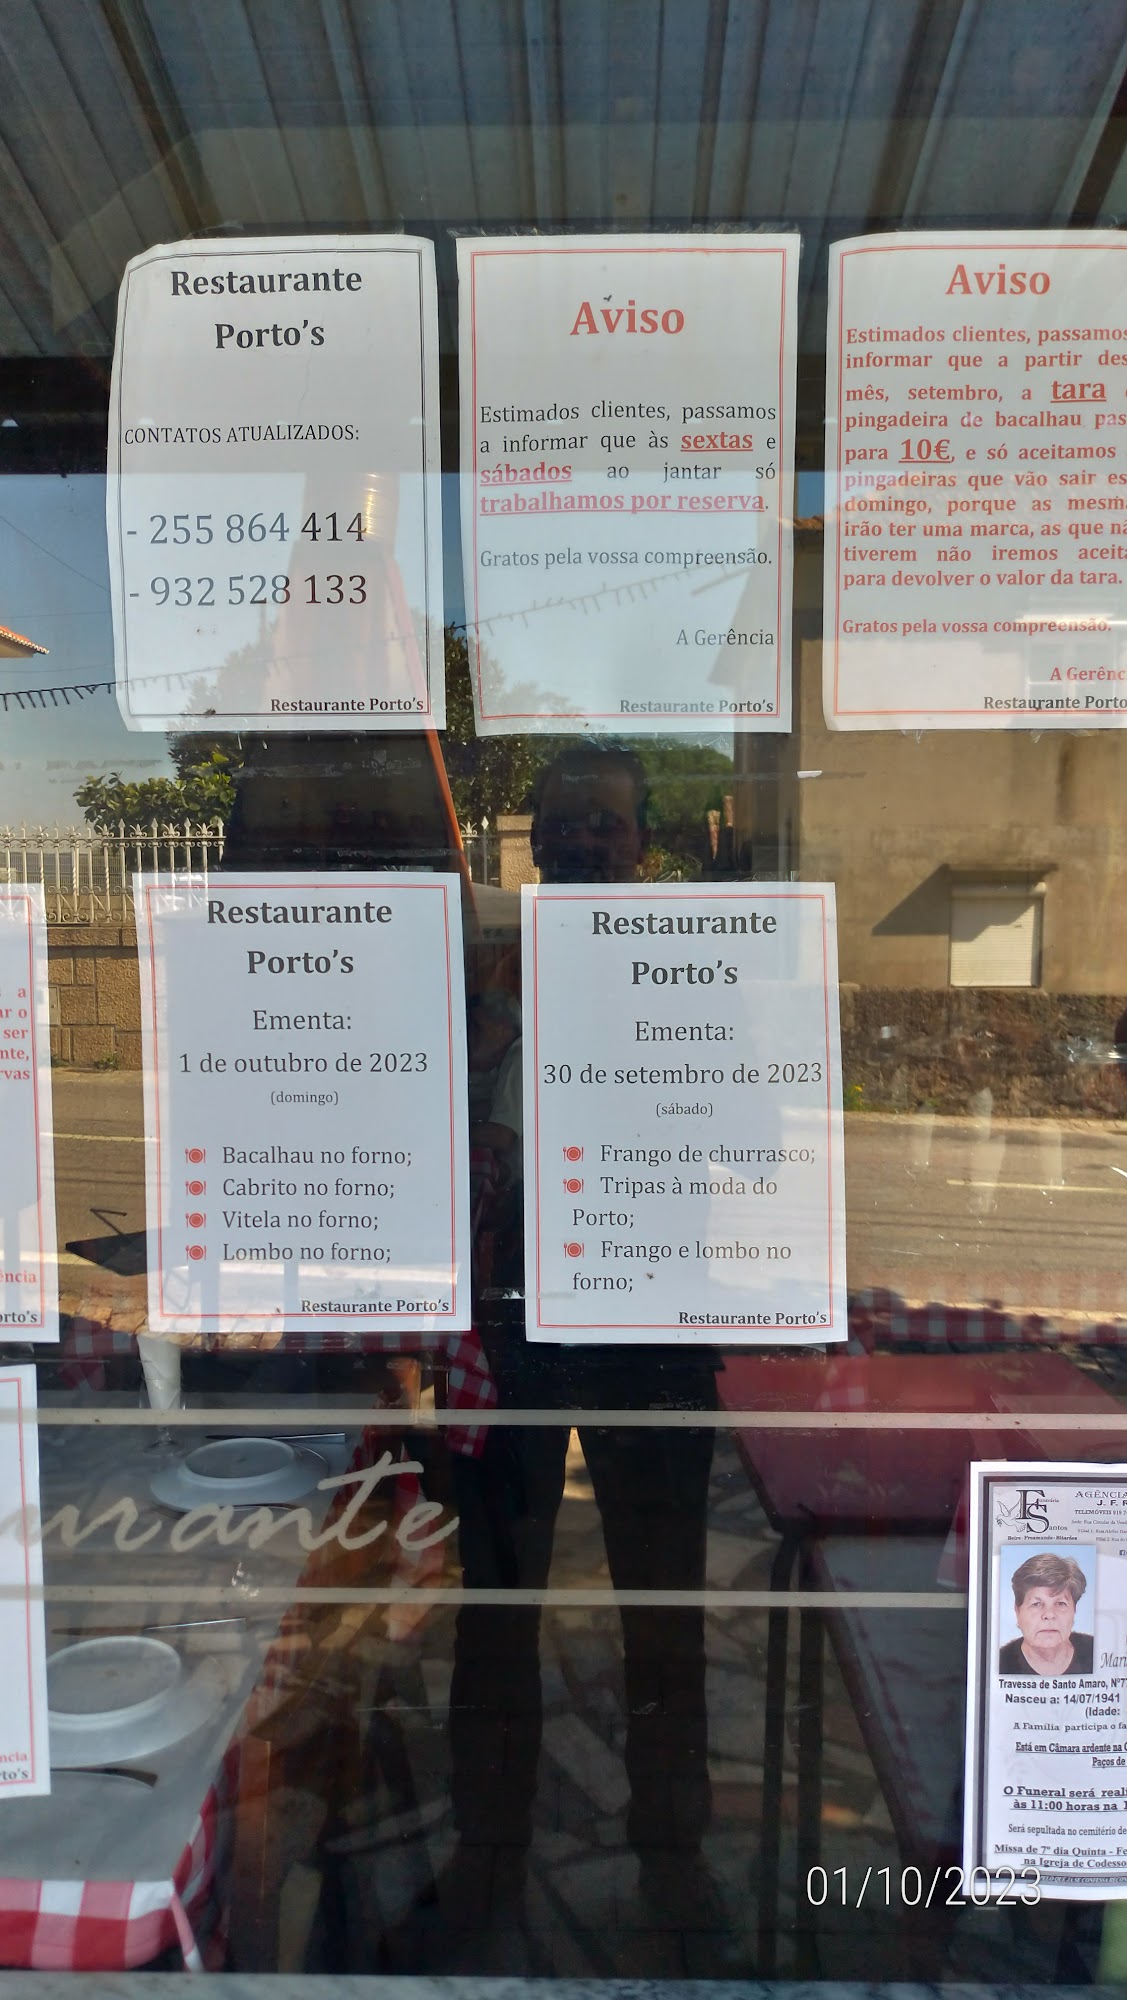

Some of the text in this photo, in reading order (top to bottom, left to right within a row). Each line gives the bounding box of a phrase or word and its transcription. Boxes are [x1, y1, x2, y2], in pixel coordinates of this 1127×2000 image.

[170, 268, 363, 296] Restaurante
[945, 263, 1051, 296] Aviso
[569, 299, 685, 336] Aviso
[214, 319, 325, 349] Porto's
[846, 325, 1031, 345] Estimados clientes,
[845, 350, 1083, 371] informar que partir
[845, 380, 1107, 404] mês, setembro, tara
[480, 399, 776, 424] Estimados clientes, passamos
[845, 410, 1127, 432] pingadeira de bacalhau pas
[124, 424, 359, 445] CONTATOS ATUALIZADOS:
[502, 430, 753, 453] informar que às sextas
[844, 438, 1117, 465] para 10€, só aceitamos
[480, 461, 776, 484] sábados ao jantar só
[845, 469, 1097, 492] pingadeiras que vão sair
[480, 491, 769, 514] trabalhamos por reserva.
[844, 495, 1052, 517] domingo, porque as
[149, 511, 368, 545] 255 864 414
[843, 520, 1104, 540] irão ter uma marca, as que
[480, 547, 772, 570] Gratos pela vossa compreensão.
[843, 544, 1058, 562] tiverem não iremos
[843, 568, 1123, 591] para devolver valor da tara.
[150, 574, 367, 607] 932 528 133
[694, 628, 774, 646] Gerência
[842, 617, 1112, 636] Gratos pela vossa compreensão.
[270, 697, 425, 712] Restaurante Porto's
[619, 698, 774, 713] Restaurante Porto's
[983, 695, 1081, 710] Restaurante
[207, 900, 393, 924] Restaurante
[591, 911, 777, 935] Restaurante
[246, 949, 354, 974] Porto's
[631, 959, 738, 985] Porto's
[252, 1009, 351, 1031] Ementa:
[3, 1029, 29, 1040] ser
[635, 1021, 734, 1042] Ementa:
[199, 1052, 428, 1073] de outubro de 2023
[544, 1062, 822, 1085] 30 de setembro de 2023
[270, 1090, 339, 1106] (domingo)
[656, 1102, 713, 1118] (sábado)
[222, 1145, 412, 1167] Bacalhau no forno;
[600, 1144, 815, 1167] Frango de churrasco;
[223, 1177, 394, 1199] Cabrito no forno;
[599, 1176, 778, 1199] Tripas moda do
[222, 1209, 378, 1232] Vitela no forno;
[572, 1208, 634, 1229] Porto;
[223, 1241, 391, 1264] Lombo no forno;
[600, 1240, 760, 1263] Frango lombo
[572, 1272, 633, 1293] forno;
[301, 1298, 450, 1313] Restaurante Porto's
[678, 1311, 827, 1325] Restaurante Porto's
[998, 1678, 1109, 1690] Travessa Santo Amaro,
[1005, 1692, 1120, 1705] Nasceu 14/07/1941
[1085, 1706, 1121, 1719] (Idade:
[1022, 1722, 1109, 1733] Família participa
[1015, 1741, 1111, 1753] Está Câmara ardente
[1092, 1756, 1115, 1768] Paços
[1017, 1786, 1095, 1798] Funeral será
[1031, 1799, 1100, 1811] 11:00 horas
[1008, 1823, 1116, 1837] Será sepultada cemitério
[994, 1843, 1106, 1857] Missa Quinta
[1039, 1857, 1069, 1869] Igreja
